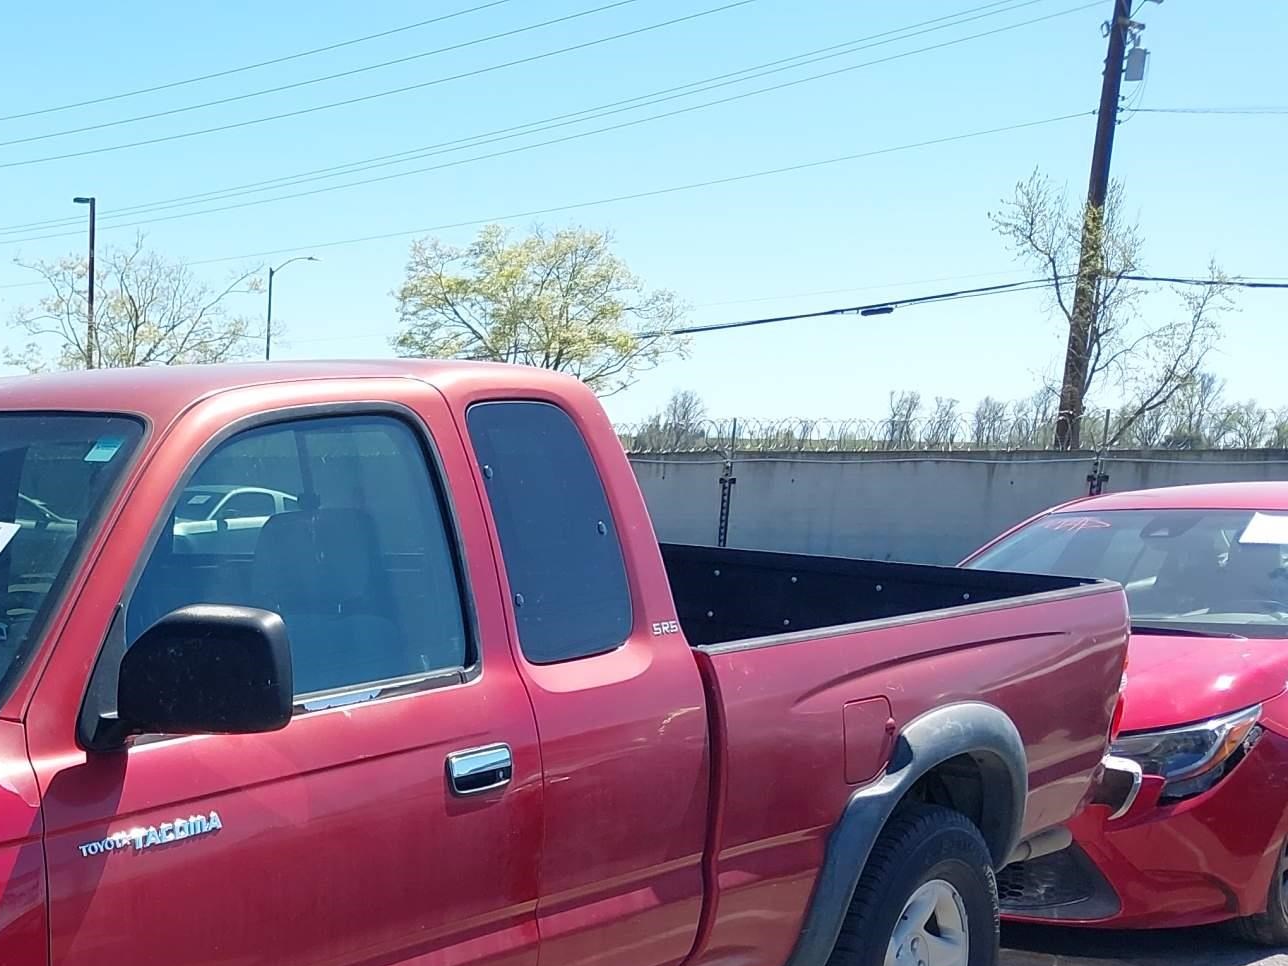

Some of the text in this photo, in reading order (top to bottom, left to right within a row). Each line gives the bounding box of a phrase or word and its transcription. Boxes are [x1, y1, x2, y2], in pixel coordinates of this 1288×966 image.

[652, 620, 679, 635] SR5
[78, 810, 223, 857] TOYOTA TACOMA
